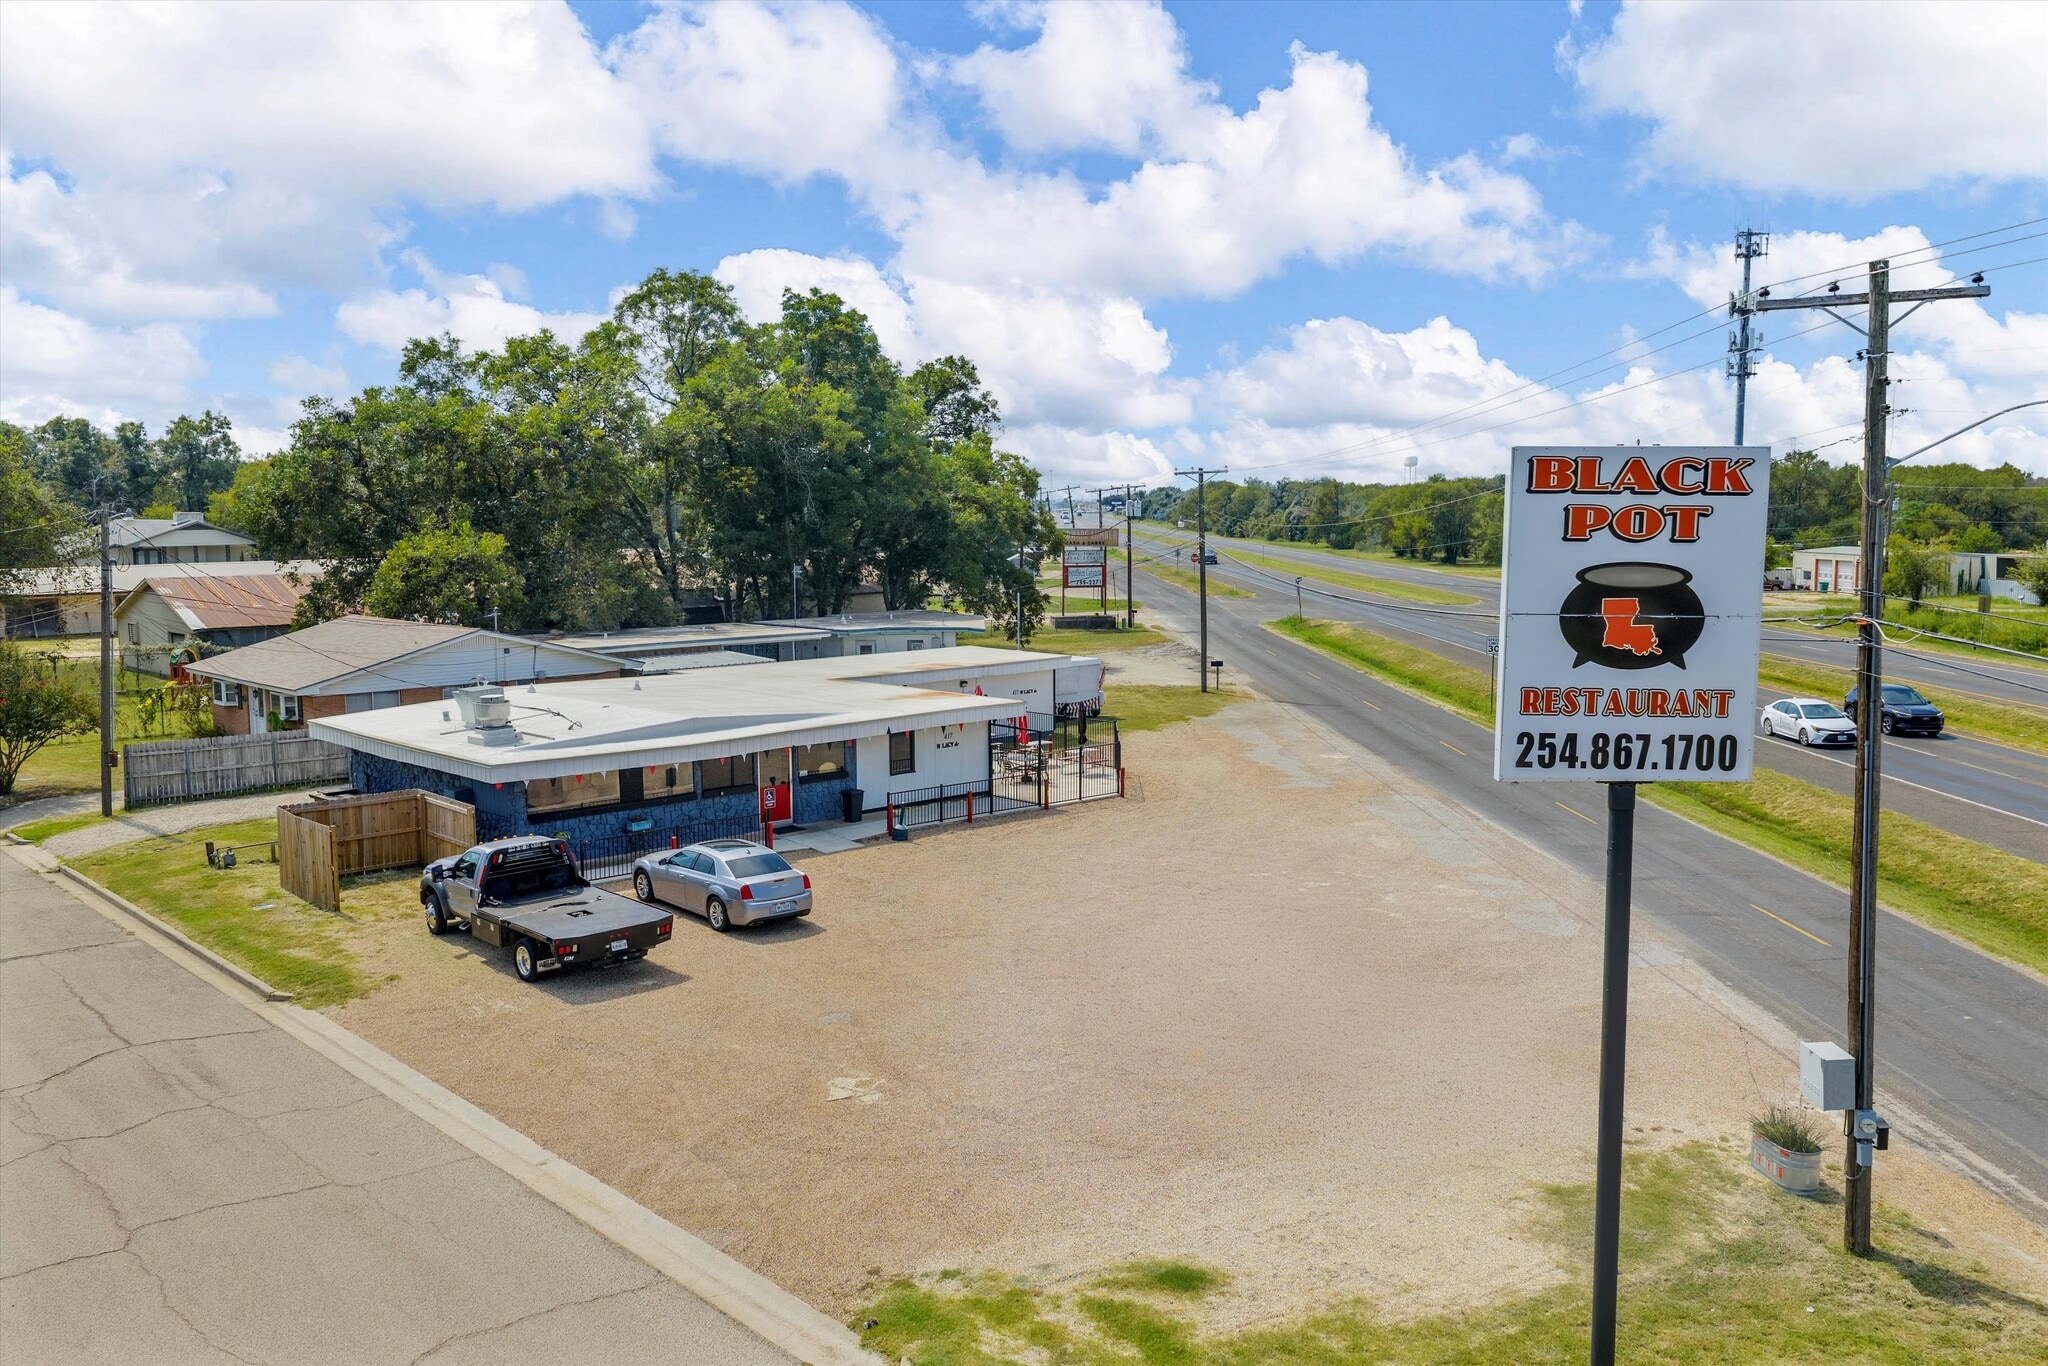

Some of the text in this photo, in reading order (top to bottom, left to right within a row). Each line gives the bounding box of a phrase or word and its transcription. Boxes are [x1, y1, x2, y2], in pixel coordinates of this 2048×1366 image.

[1526, 456, 1755, 495] BLACK
[1562, 504, 1713, 542] POT
[1519, 687, 1735, 718] RESTAURANT
[1515, 732, 1738, 771] 254.867.1700
